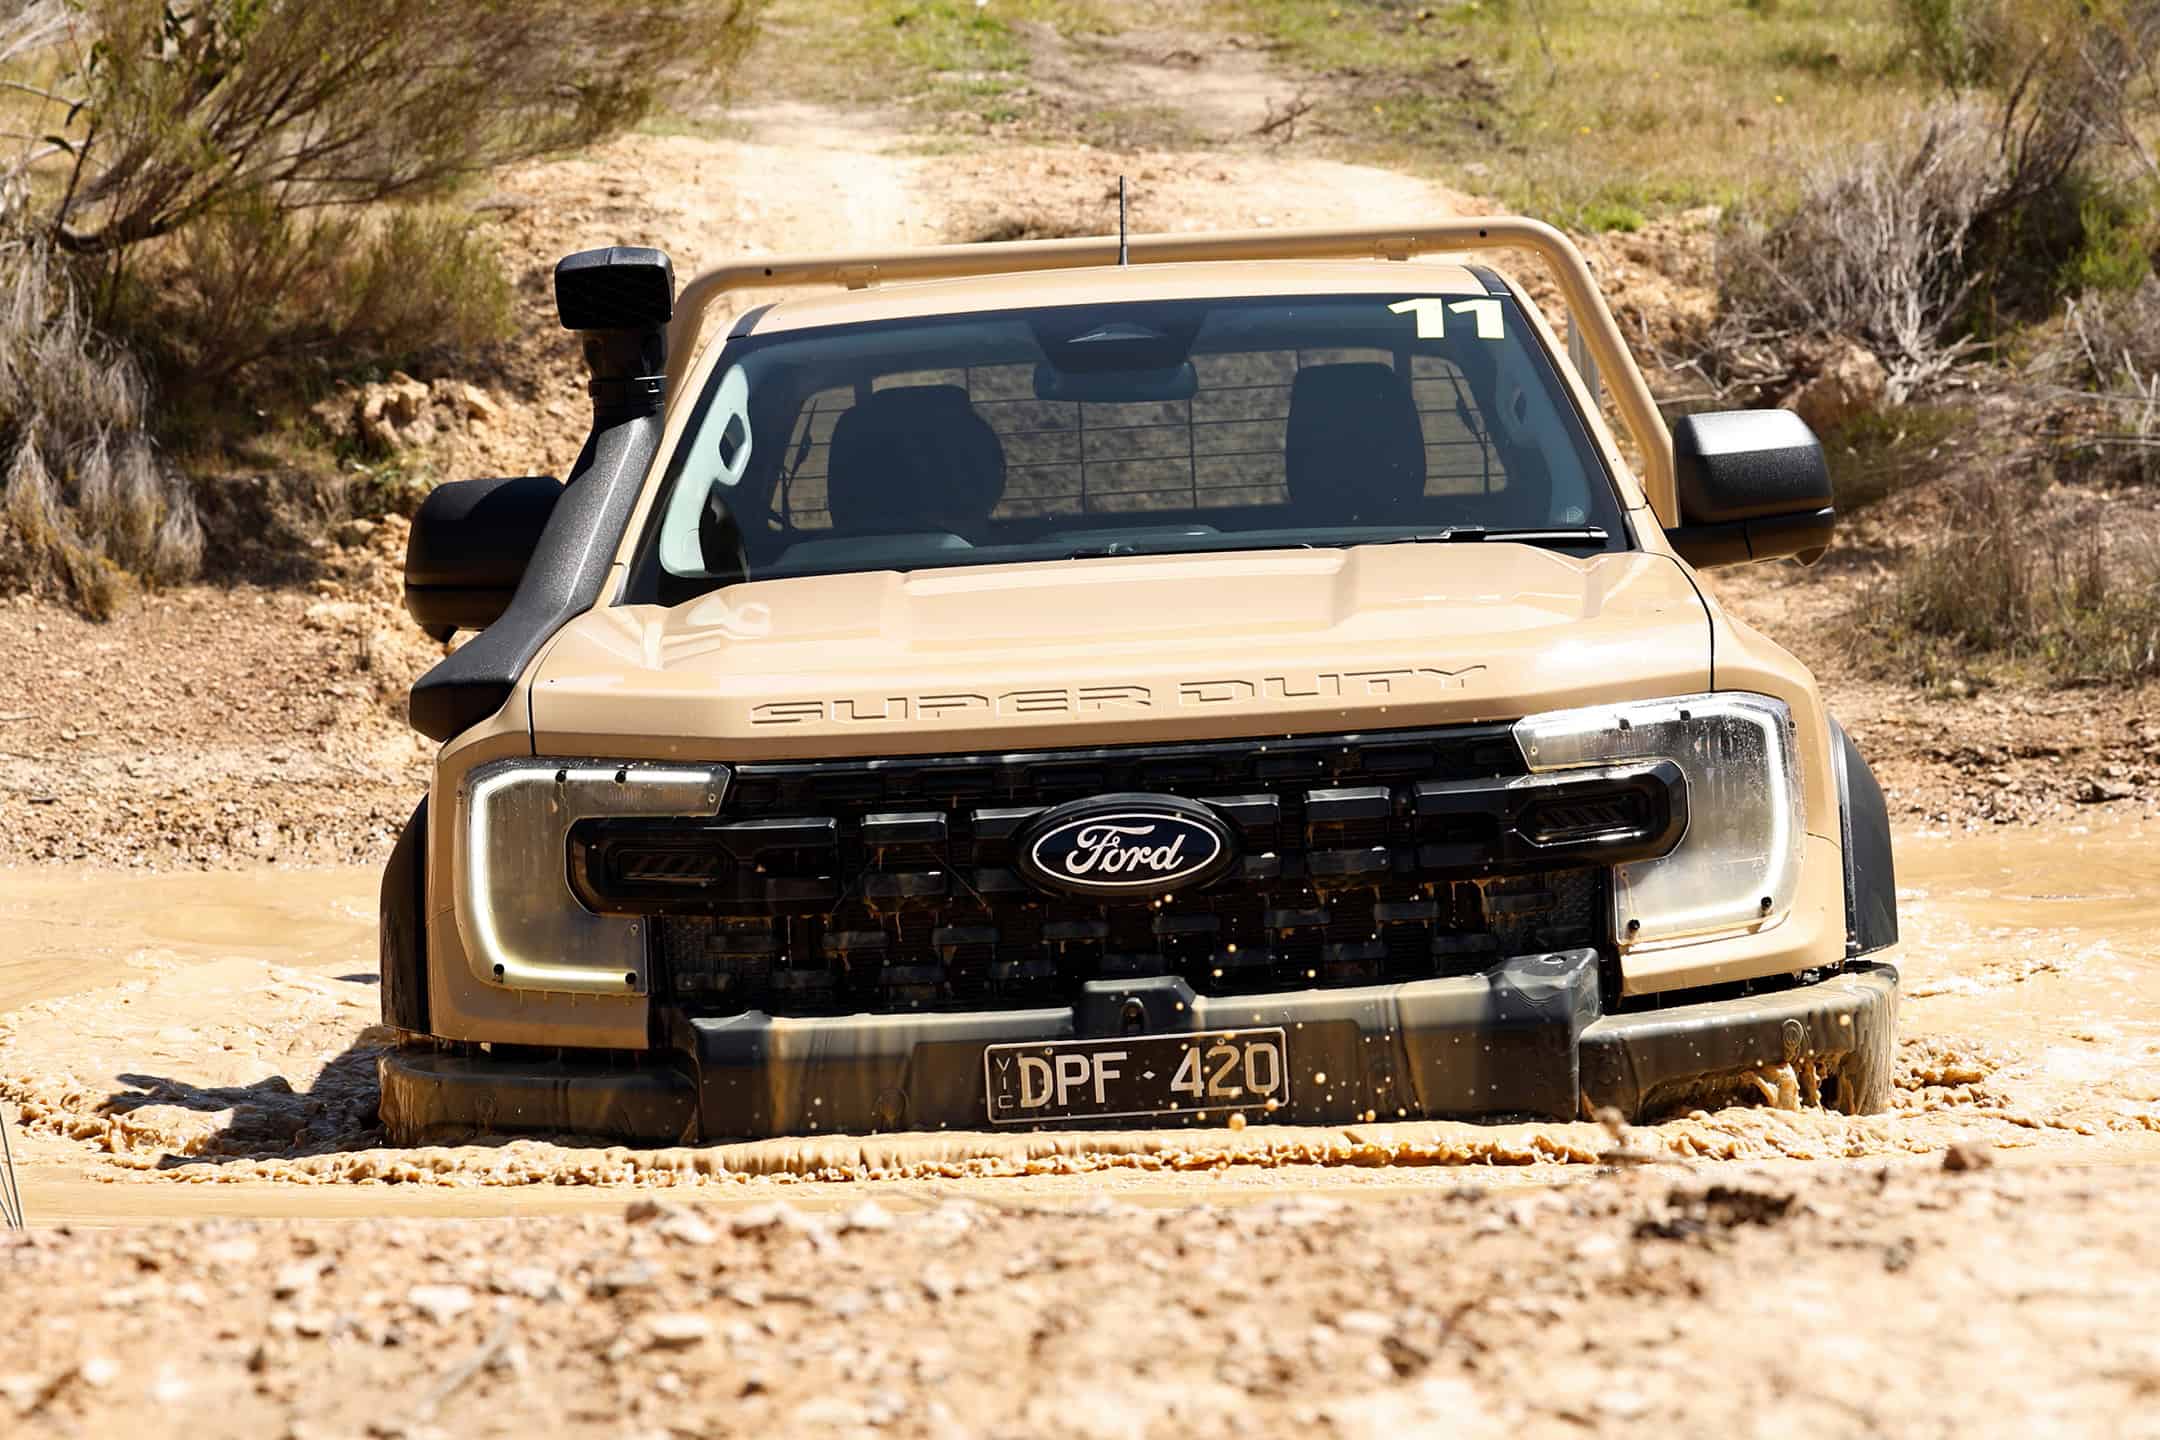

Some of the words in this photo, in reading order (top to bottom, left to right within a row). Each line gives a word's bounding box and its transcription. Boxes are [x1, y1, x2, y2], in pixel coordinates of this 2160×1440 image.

[1386, 297, 1505, 340] 11
[751, 685, 1152, 726] SUPER
[1178, 664, 1487, 706] DUTY
[1065, 824, 1186, 875] Ford
[996, 1057, 1014, 1109] VIC
[1017, 1051, 1128, 1109] DPF
[1170, 1042, 1281, 1098] 420
